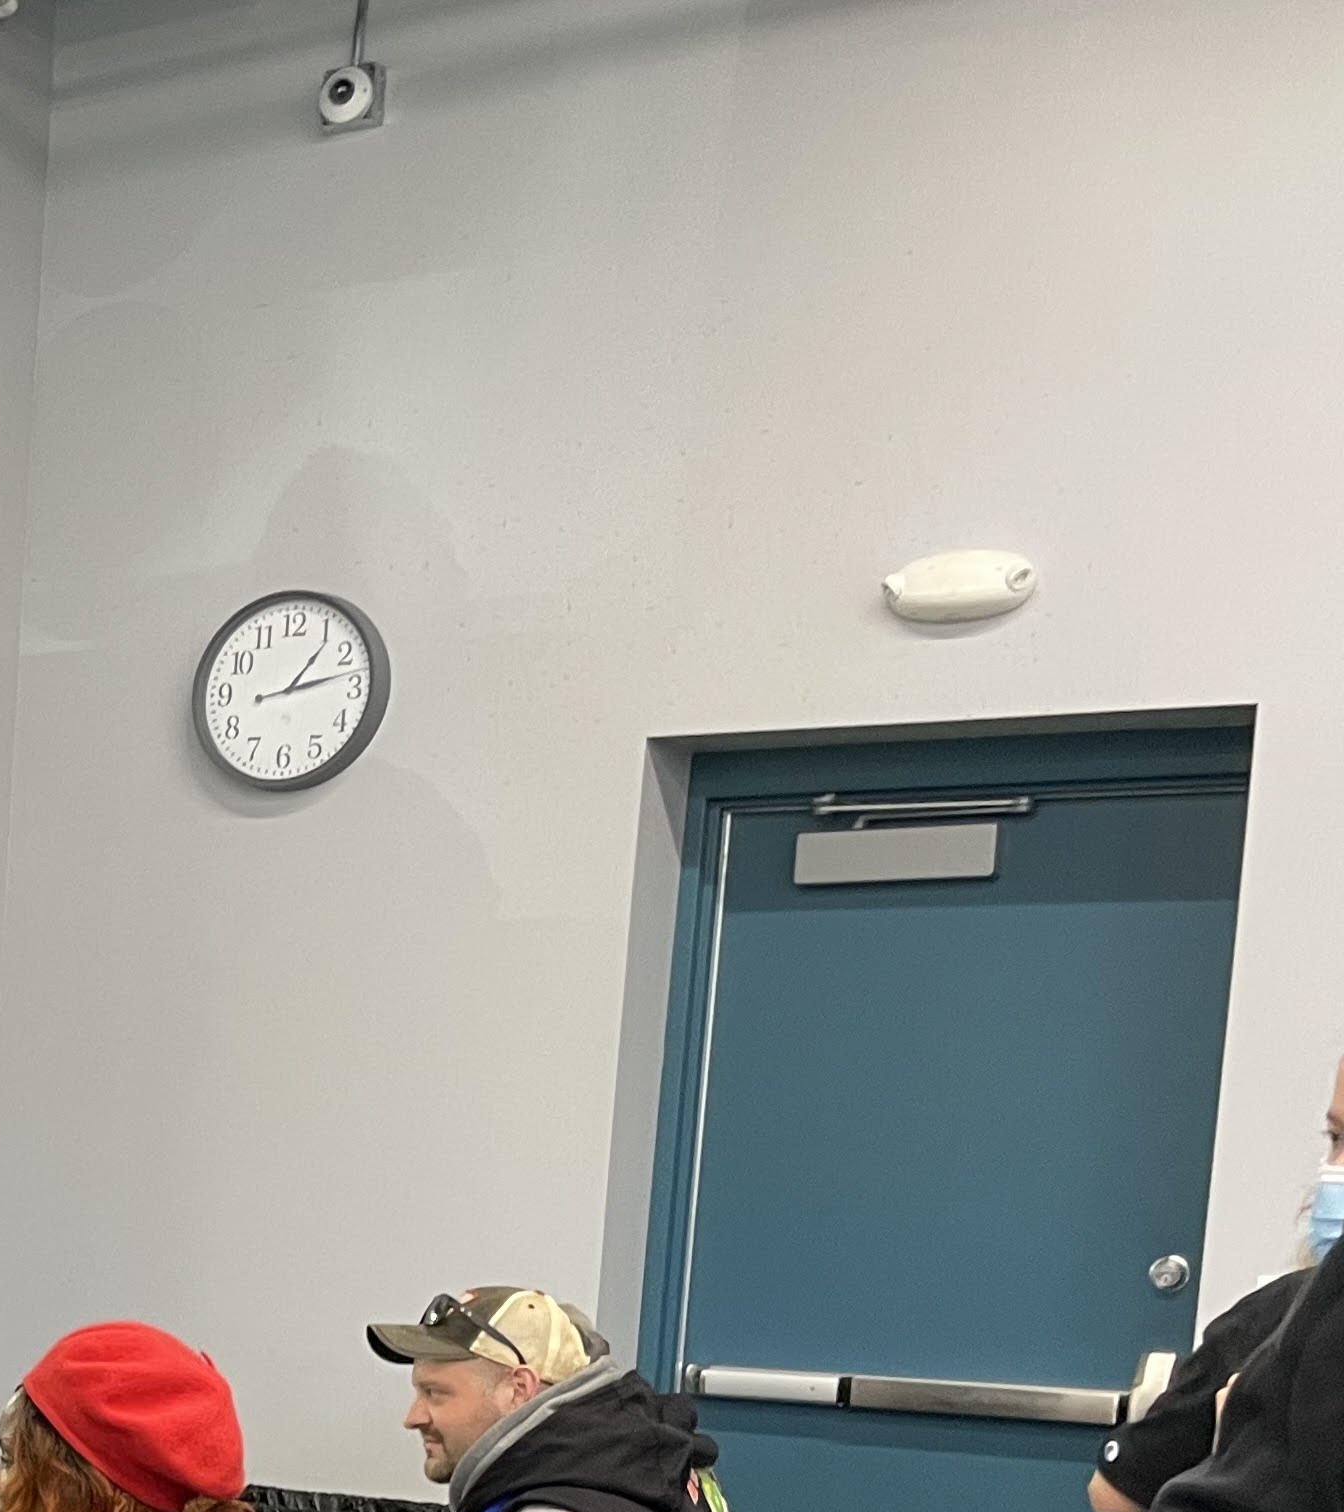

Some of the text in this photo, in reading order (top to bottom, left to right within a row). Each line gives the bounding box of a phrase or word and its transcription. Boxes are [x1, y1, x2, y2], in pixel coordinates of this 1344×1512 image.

[255, 624, 273, 650] 11
[282, 611, 307, 638] 12
[231, 650, 254, 676] 10
[337, 640, 353, 666] 2
[217, 682, 233, 707] 9
[346, 673, 362, 700] 3
[224, 715, 240, 740] 8
[332, 708, 348, 733] 4
[247, 736, 261, 762] 7
[276, 744, 292, 769] 6
[307, 734, 324, 759] 5
